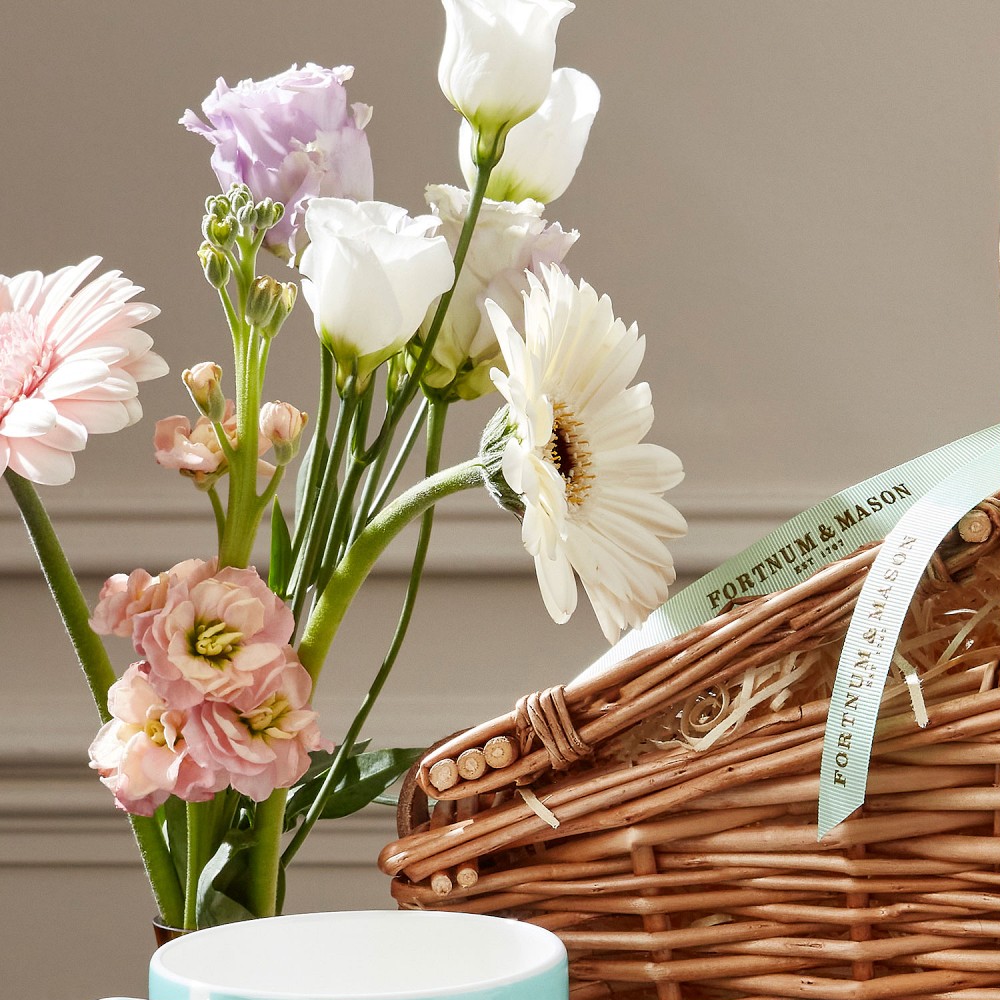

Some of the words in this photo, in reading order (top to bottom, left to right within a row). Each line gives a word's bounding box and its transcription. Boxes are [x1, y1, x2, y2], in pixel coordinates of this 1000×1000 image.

[706, 532, 818, 609] FORTNUM
[818, 523, 836, 542] &
[834, 483, 912, 533] MASON
[794, 557, 814, 574] EST
[868, 535, 918, 621] MASON
[863, 627, 877, 644] &
[834, 649, 871, 788] FORTNUM
